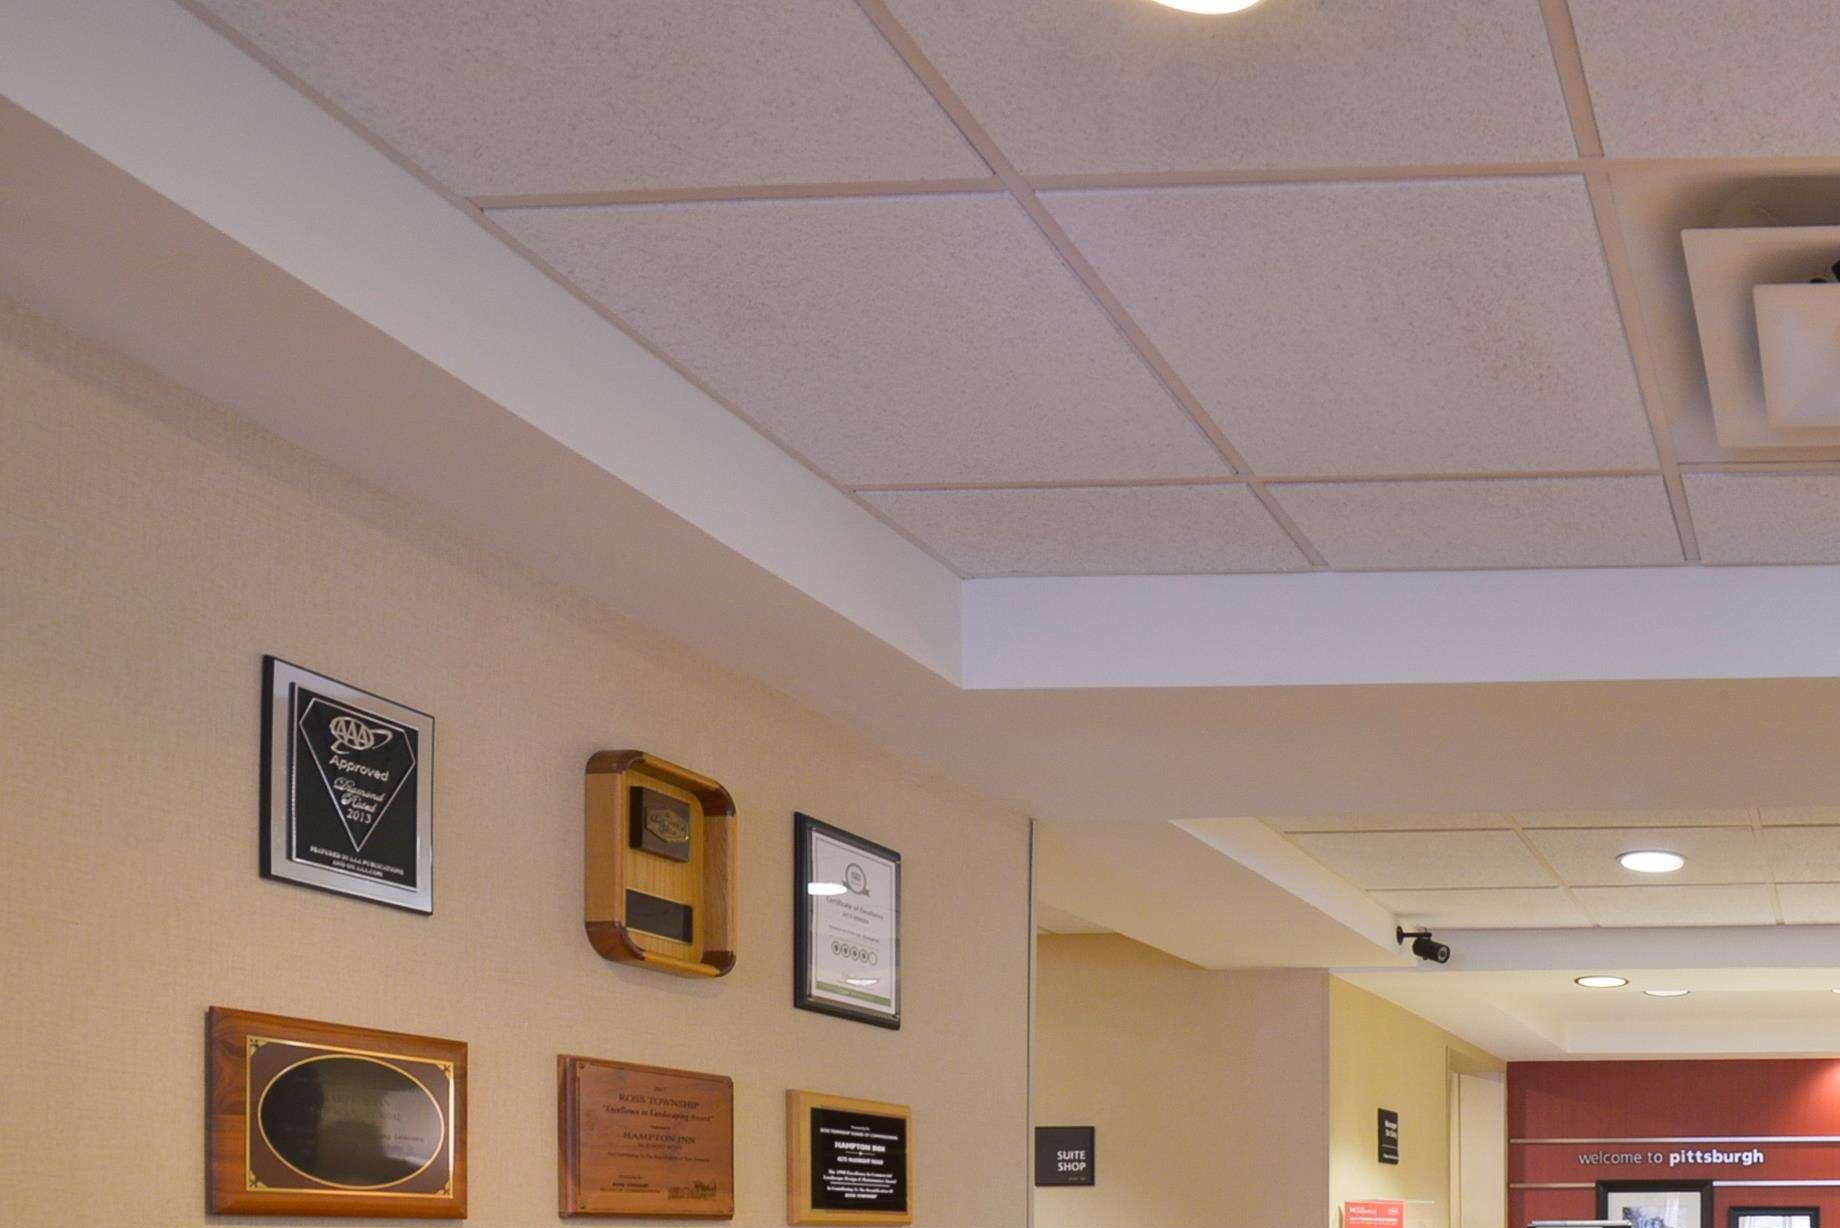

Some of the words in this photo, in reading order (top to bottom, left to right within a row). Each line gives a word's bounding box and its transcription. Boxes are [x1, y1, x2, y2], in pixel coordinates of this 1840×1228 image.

[333, 717, 372, 748] AAA
[329, 755, 389, 781] Approved
[346, 809, 372, 824] 2013
[623, 1131, 675, 1142] HAMPTON
[1057, 1150, 1086, 1160] SUITE
[1579, 1151, 1642, 1164] welcome
[1647, 1152, 1663, 1164] to
[1669, 1149, 1764, 1167] pittsburgh
[1057, 1162, 1086, 1171] SHOP
